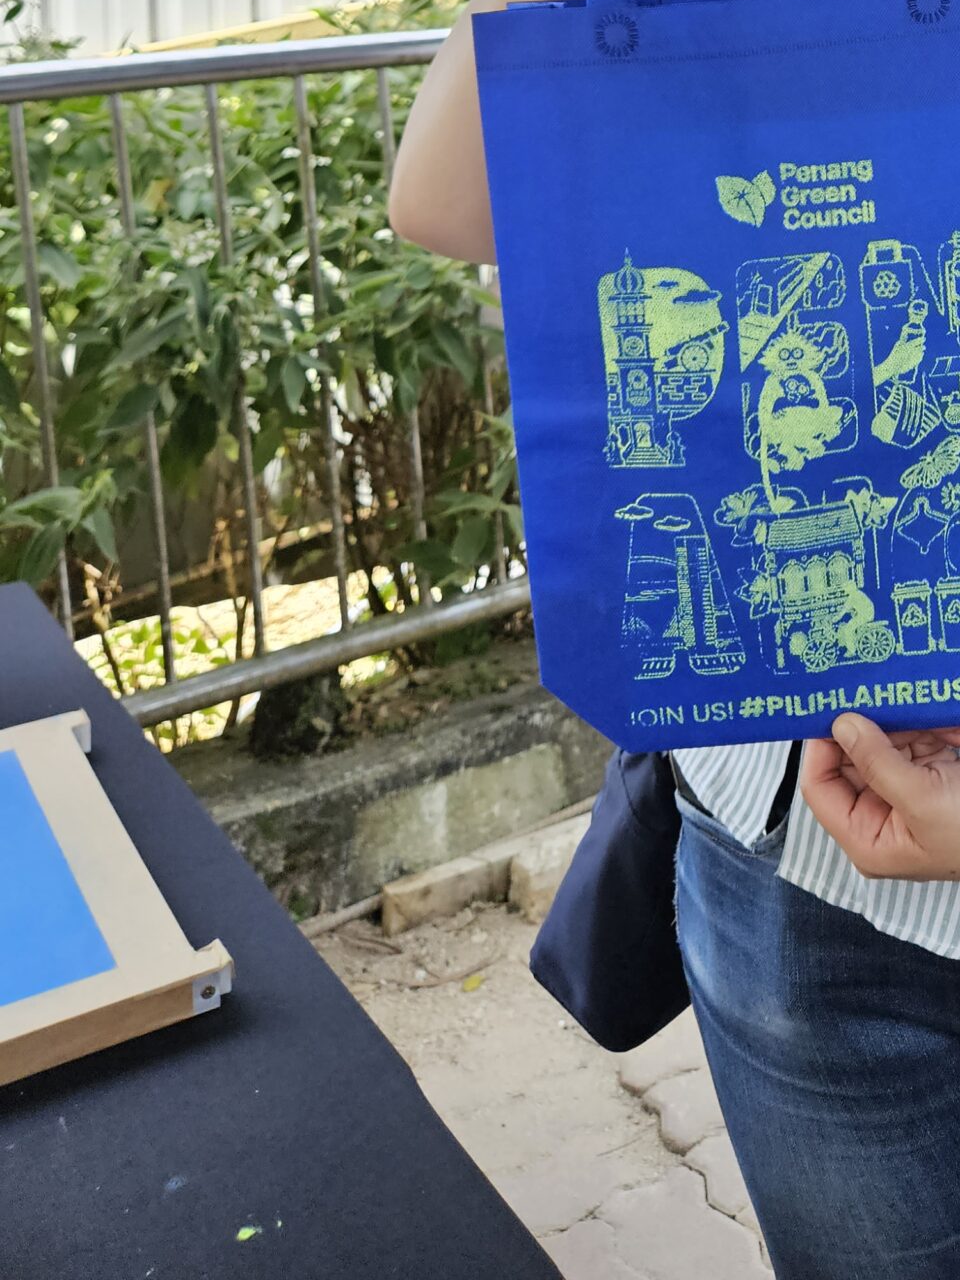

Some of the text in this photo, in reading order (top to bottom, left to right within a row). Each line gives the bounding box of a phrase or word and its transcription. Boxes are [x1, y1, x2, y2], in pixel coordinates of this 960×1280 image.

[779, 159, 874, 183] Penang
[781, 184, 857, 208] Green
[783, 200, 877, 231] Council
[692, 701, 735, 723] US!
